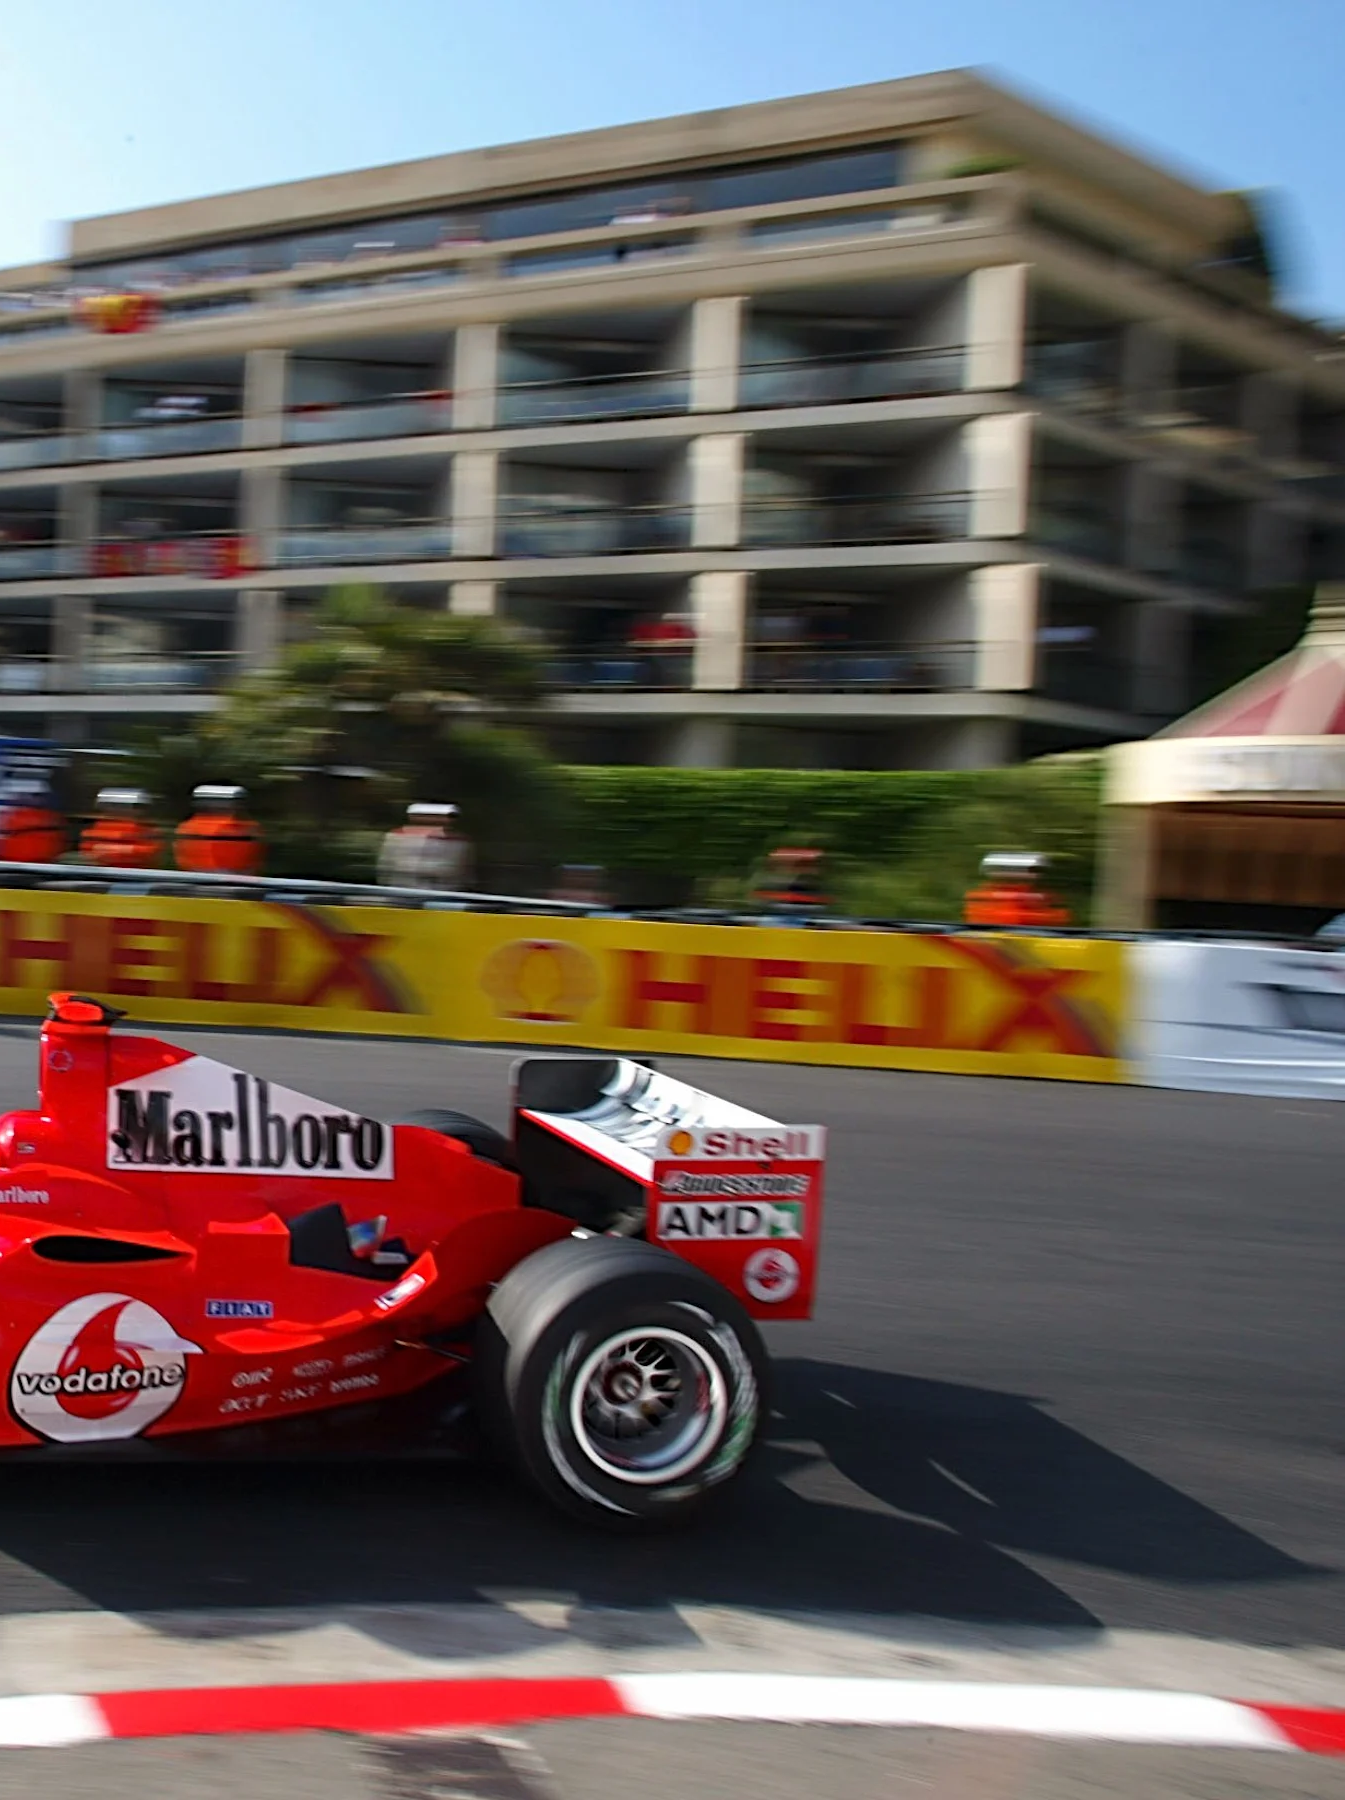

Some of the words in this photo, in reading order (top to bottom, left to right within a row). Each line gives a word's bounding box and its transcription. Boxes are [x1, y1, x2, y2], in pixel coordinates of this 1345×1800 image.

[617, 936, 1114, 1057] HELIX
[111, 1073, 384, 1171] Marlboro
[703, 1131, 810, 1158] Shell
[660, 1205, 762, 1237] AMD
[209, 1301, 269, 1316] FIAT
[17, 1363, 185, 1395] vodafone
